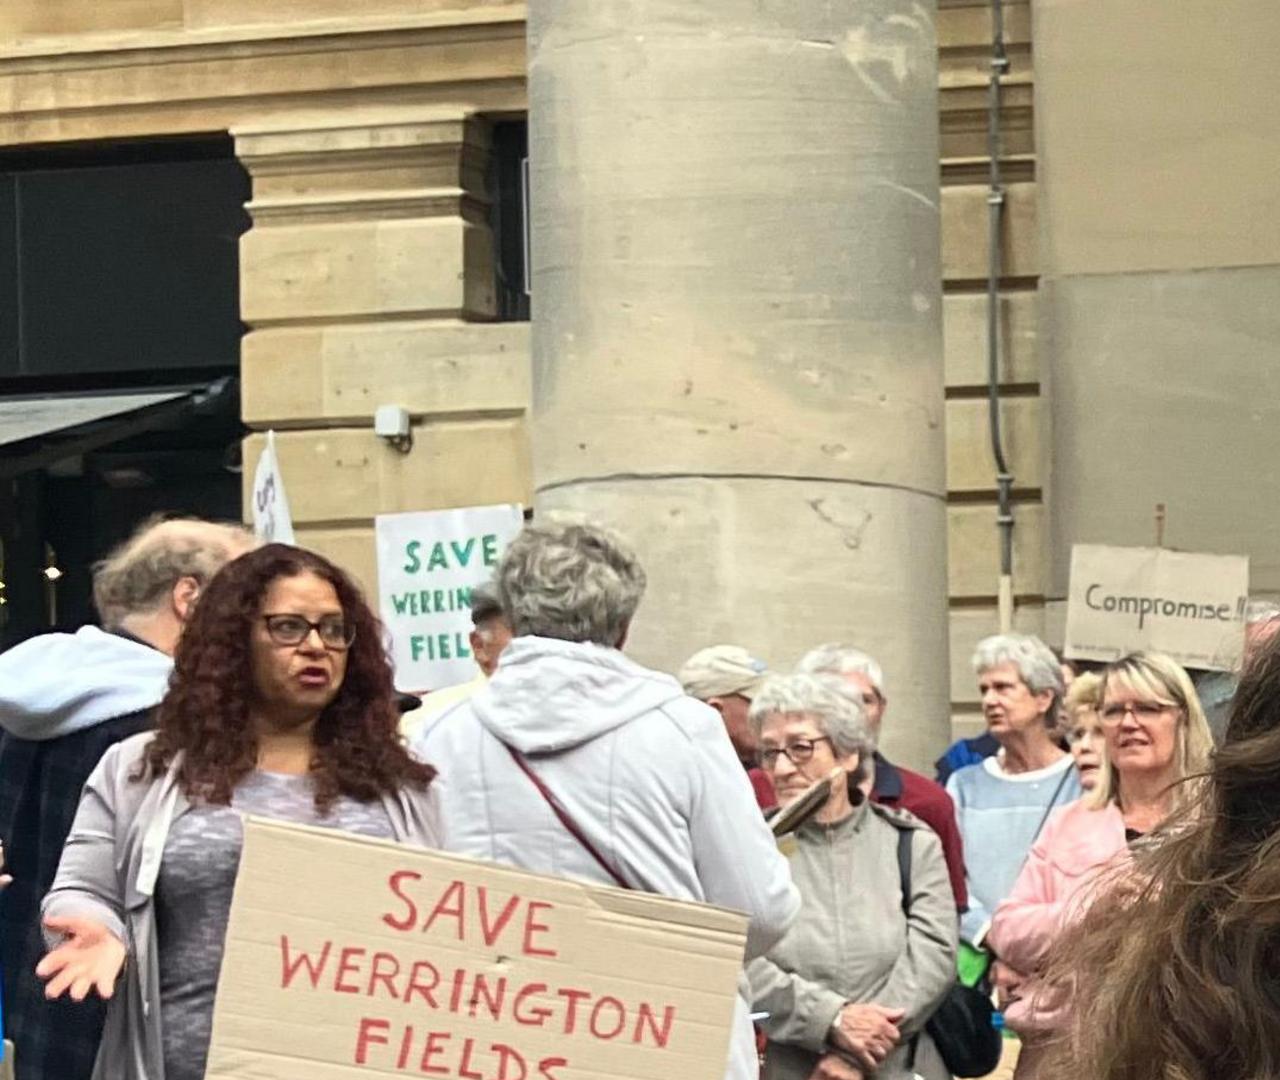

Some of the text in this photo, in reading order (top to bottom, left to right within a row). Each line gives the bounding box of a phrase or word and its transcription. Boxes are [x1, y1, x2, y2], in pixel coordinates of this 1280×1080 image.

[404, 534, 498, 575] SAVE
[392, 586, 472, 616] WERRIN
[410, 632, 470, 662] FIEL
[381, 869, 560, 958] SAVE
[279, 934, 676, 1049] WERRINGTON
